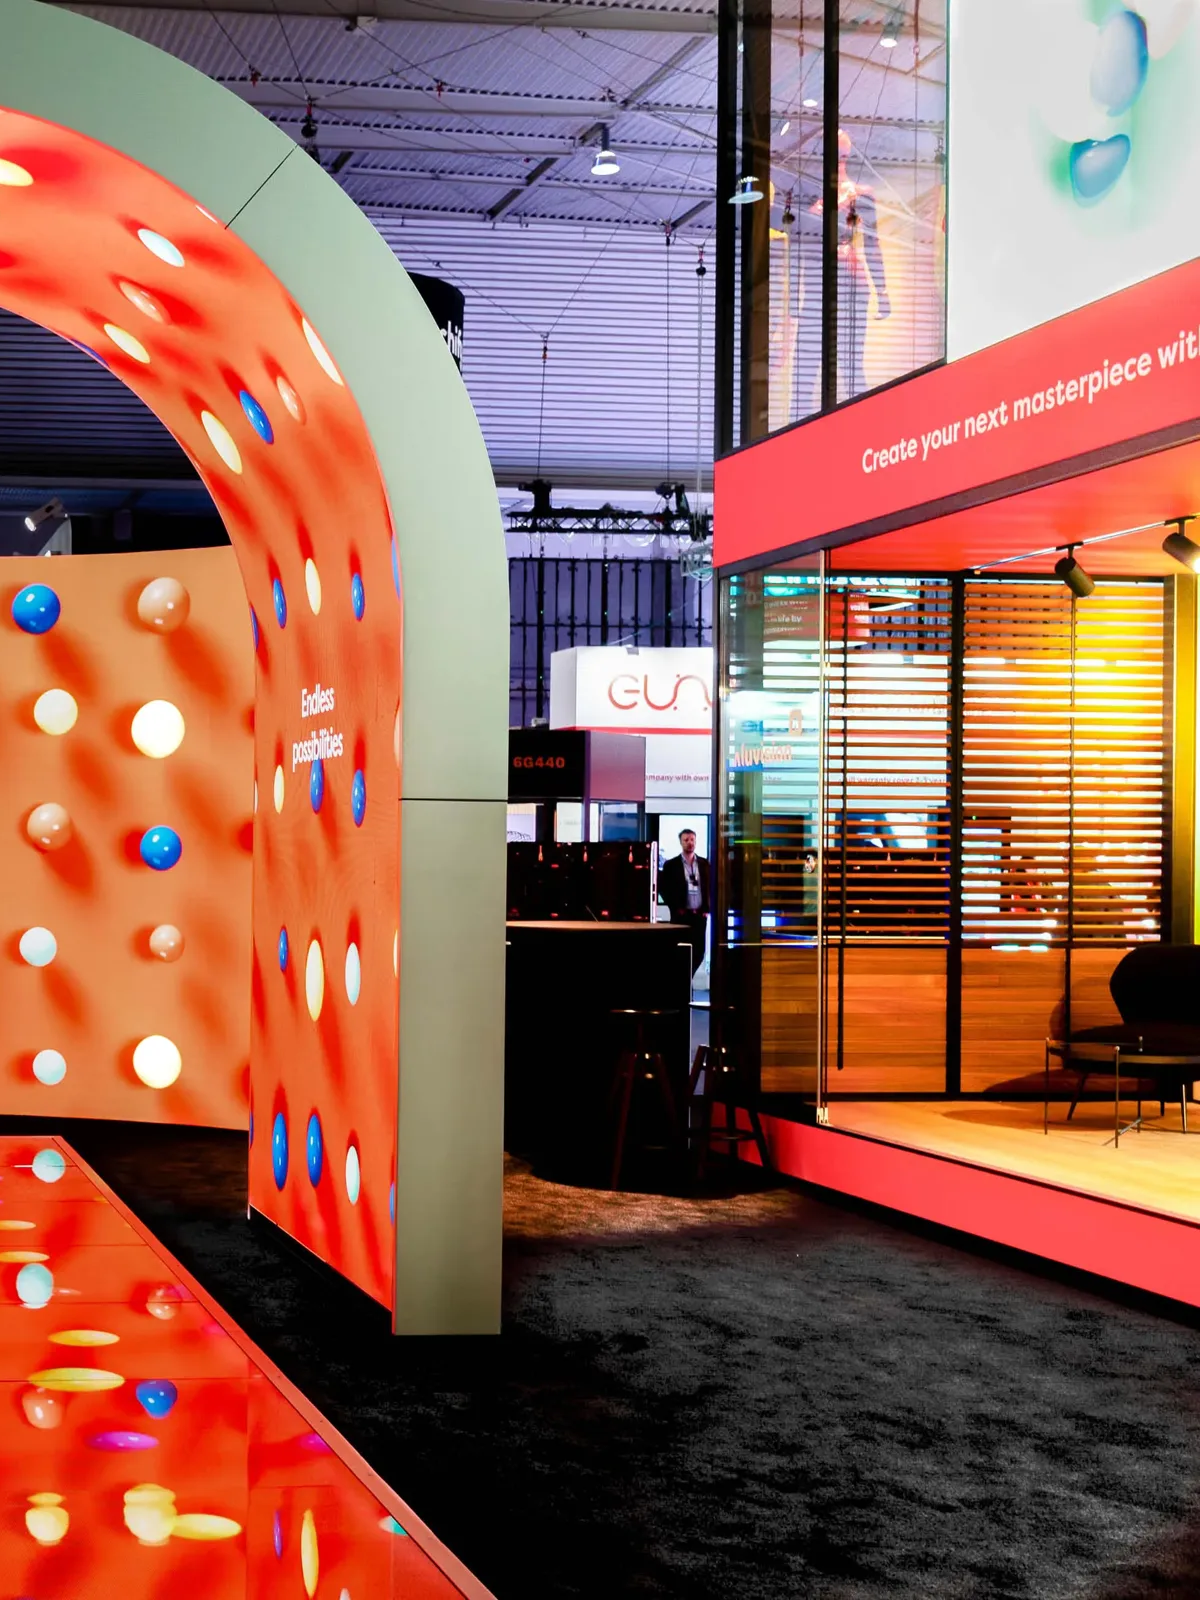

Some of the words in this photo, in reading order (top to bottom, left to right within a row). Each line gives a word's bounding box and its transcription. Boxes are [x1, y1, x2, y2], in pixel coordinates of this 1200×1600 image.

[862, 436, 917, 473] Create
[920, 420, 960, 461] your
[964, 402, 1008, 439] next
[1012, 352, 1152, 422] masterpiece
[301, 683, 334, 718] Endless
[292, 726, 343, 773] possibilities
[512, 756, 566, 769] 6G440
[675, 773, 692, 781] with
